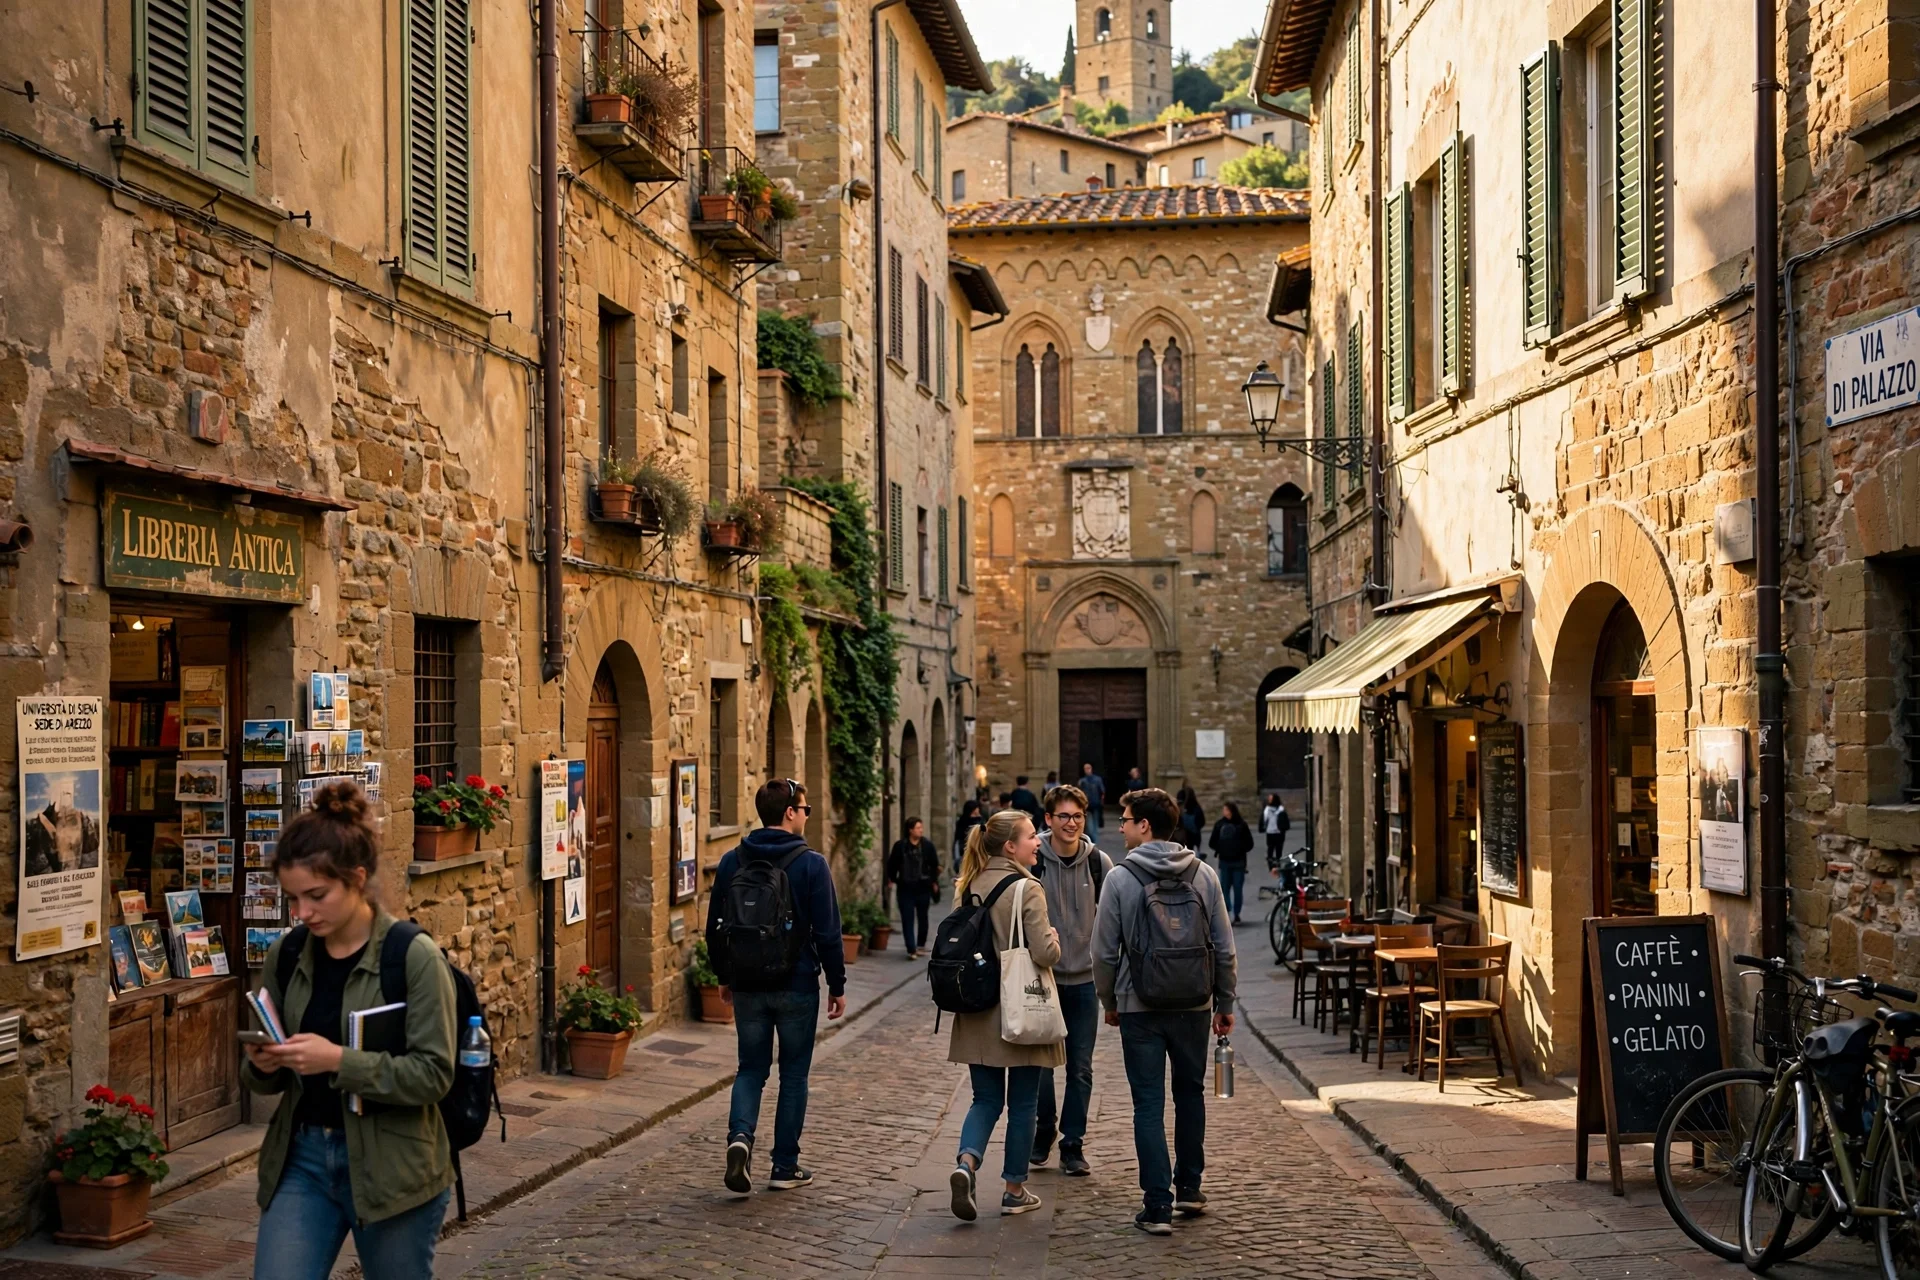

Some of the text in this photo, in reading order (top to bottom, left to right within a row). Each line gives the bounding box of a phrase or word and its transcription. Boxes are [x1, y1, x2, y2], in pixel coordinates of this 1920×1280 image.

[1860, 329, 1885, 365] VIA
[1833, 359, 1916, 415] DI PALAZZO
[122, 508, 295, 576] LIBRERIA ANTICA
[69, 703, 75, 714] DI
[34, 718, 54, 730] SEDE
[1615, 935, 1683, 967] CAFFÈ
[1621, 983, 1691, 1009] PANINI
[1624, 1025, 1705, 1053] GELATO
